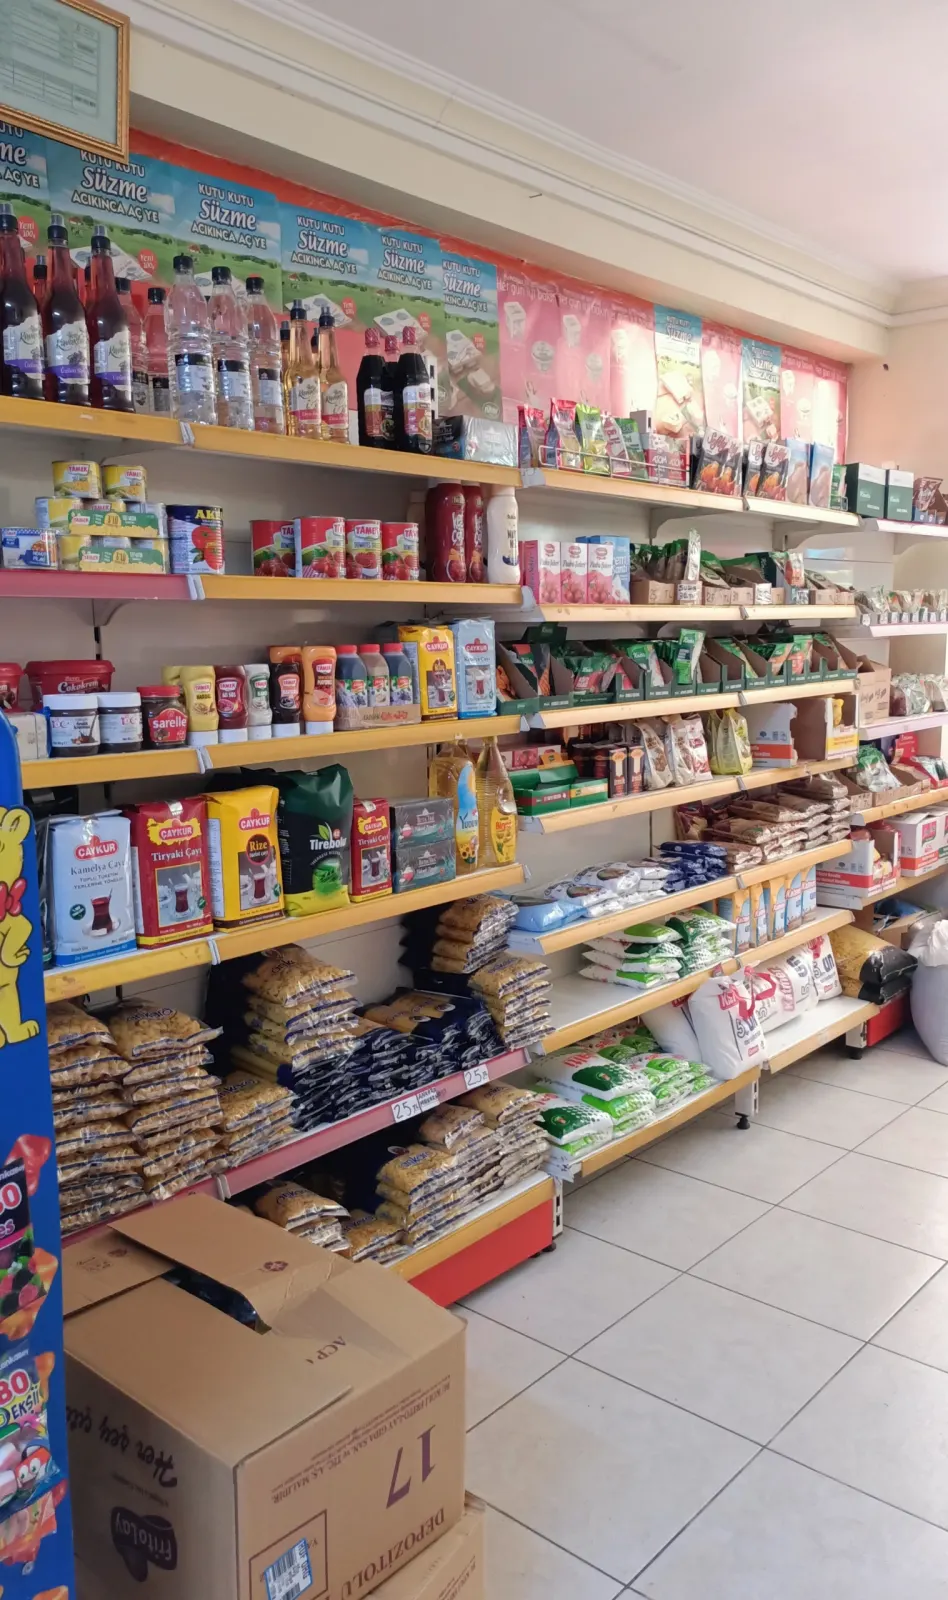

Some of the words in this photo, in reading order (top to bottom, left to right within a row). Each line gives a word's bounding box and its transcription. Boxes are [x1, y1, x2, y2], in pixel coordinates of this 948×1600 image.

[81, 167, 148, 202] Süzme
[198, 183, 226, 199] KUTU
[227, 191, 254, 207] KUTU
[71, 190, 126, 215] ACIKINCA
[127, 206, 143, 221] AÇ
[144, 208, 160, 223] YE
[199, 198, 257, 231] Süzme
[191, 220, 237, 243] ACIKINCA
[238, 233, 252, 248] AÇ
[254, 236, 267, 249] YE
[296, 215, 321, 230] KUTU
[322, 221, 345, 236] KUTU
[298, 230, 348, 258] Süzme
[381, 235, 401, 249] KUTU
[402, 240, 423, 254] KUTU
[291, 251, 332, 270] ACIKINCA
[333, 262, 346, 274] AÇ
[346, 263, 358, 275] YE
[383, 248, 425, 274] Süzme
[462, 264, 481, 278] KUTU
[421, 279, 433, 291] YE
[442, 272, 481, 297] Süzme
[152, 716, 187, 729] sarelle
[160, 826, 192, 841] ÇAYKUR
[249, 840, 268, 852] Rize
[310, 836, 347, 851] Tirebolu
[151, 850, 184, 863] Tiryaki
[185, 846, 202, 858] Çayı
[70, 862, 106, 877] Kamelya
[465, 1068, 482, 1086] 25
[394, 1101, 412, 1120] 25
